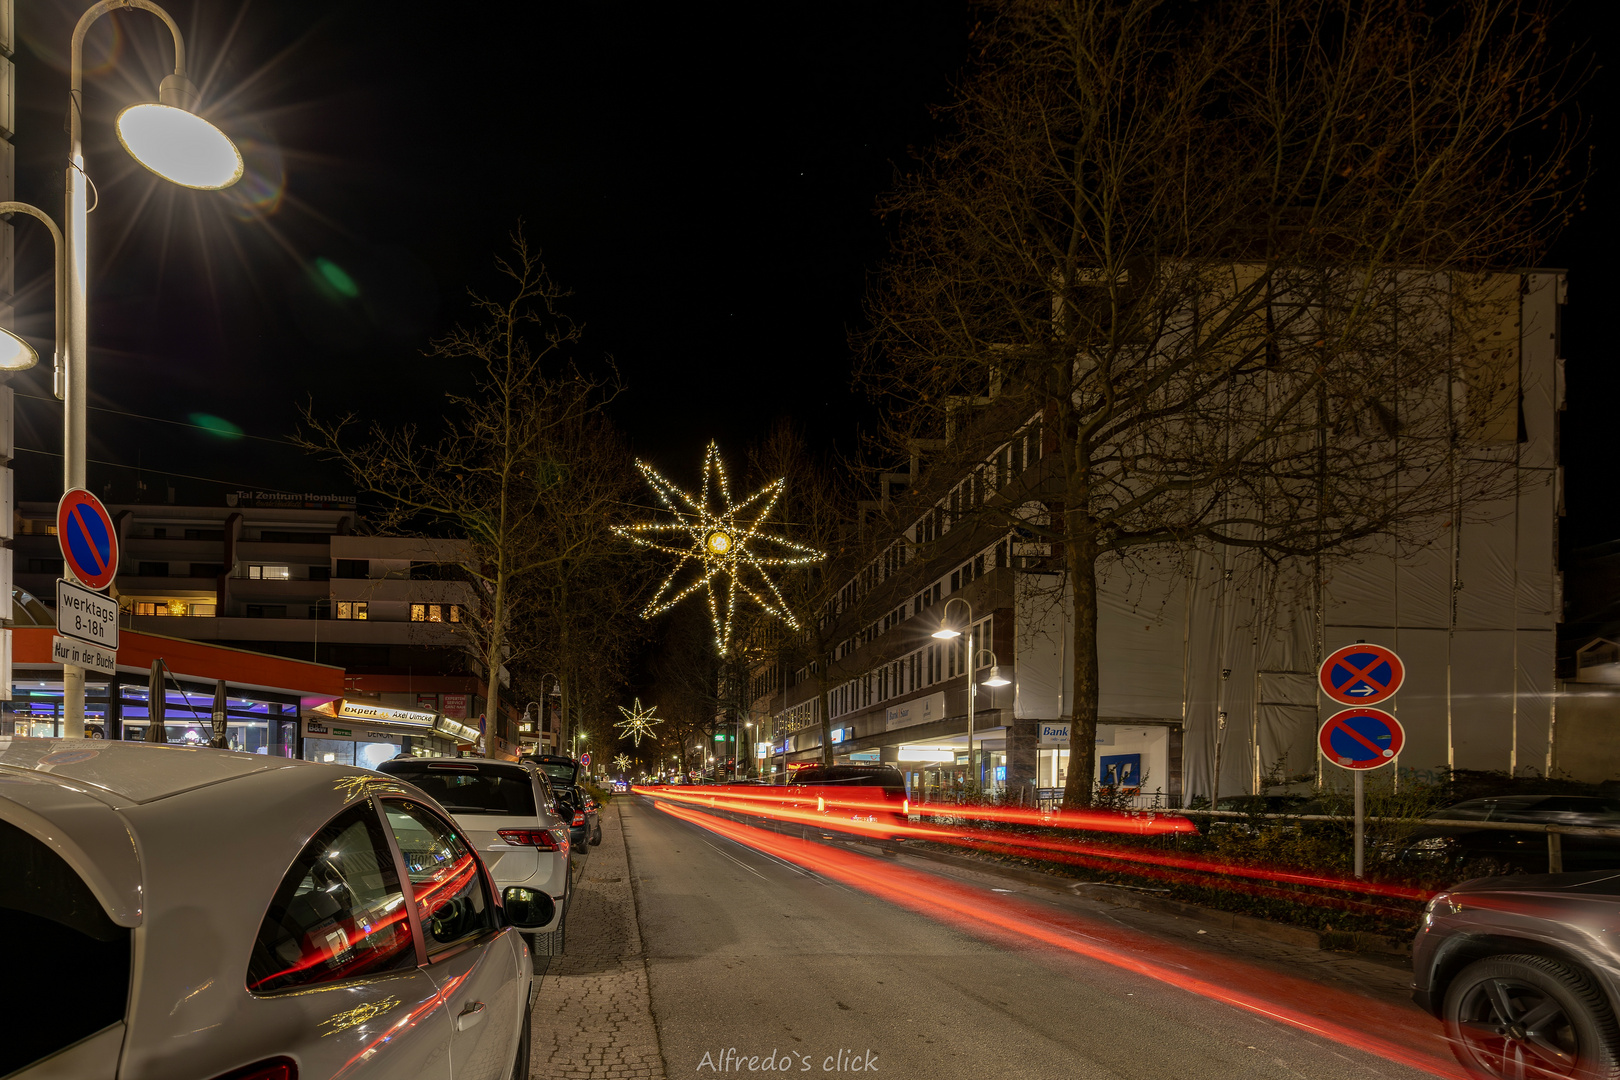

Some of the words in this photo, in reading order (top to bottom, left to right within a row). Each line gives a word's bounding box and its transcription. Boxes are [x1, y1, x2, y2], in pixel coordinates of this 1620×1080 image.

[236, 490, 253, 499] Tal
[255, 491, 302, 501] Zentrum
[304, 493, 357, 503] Homburg
[63, 593, 114, 623] werktags
[75, 615, 104, 638] 8-18h
[54, 641, 70, 659] Nur
[72, 646, 80, 661] in
[82, 649, 95, 665] der
[96, 652, 115, 670] Bucht
[344, 705, 378, 716] expert
[392, 711, 409, 719] Axel
[1043, 726, 1069, 737] Bank
